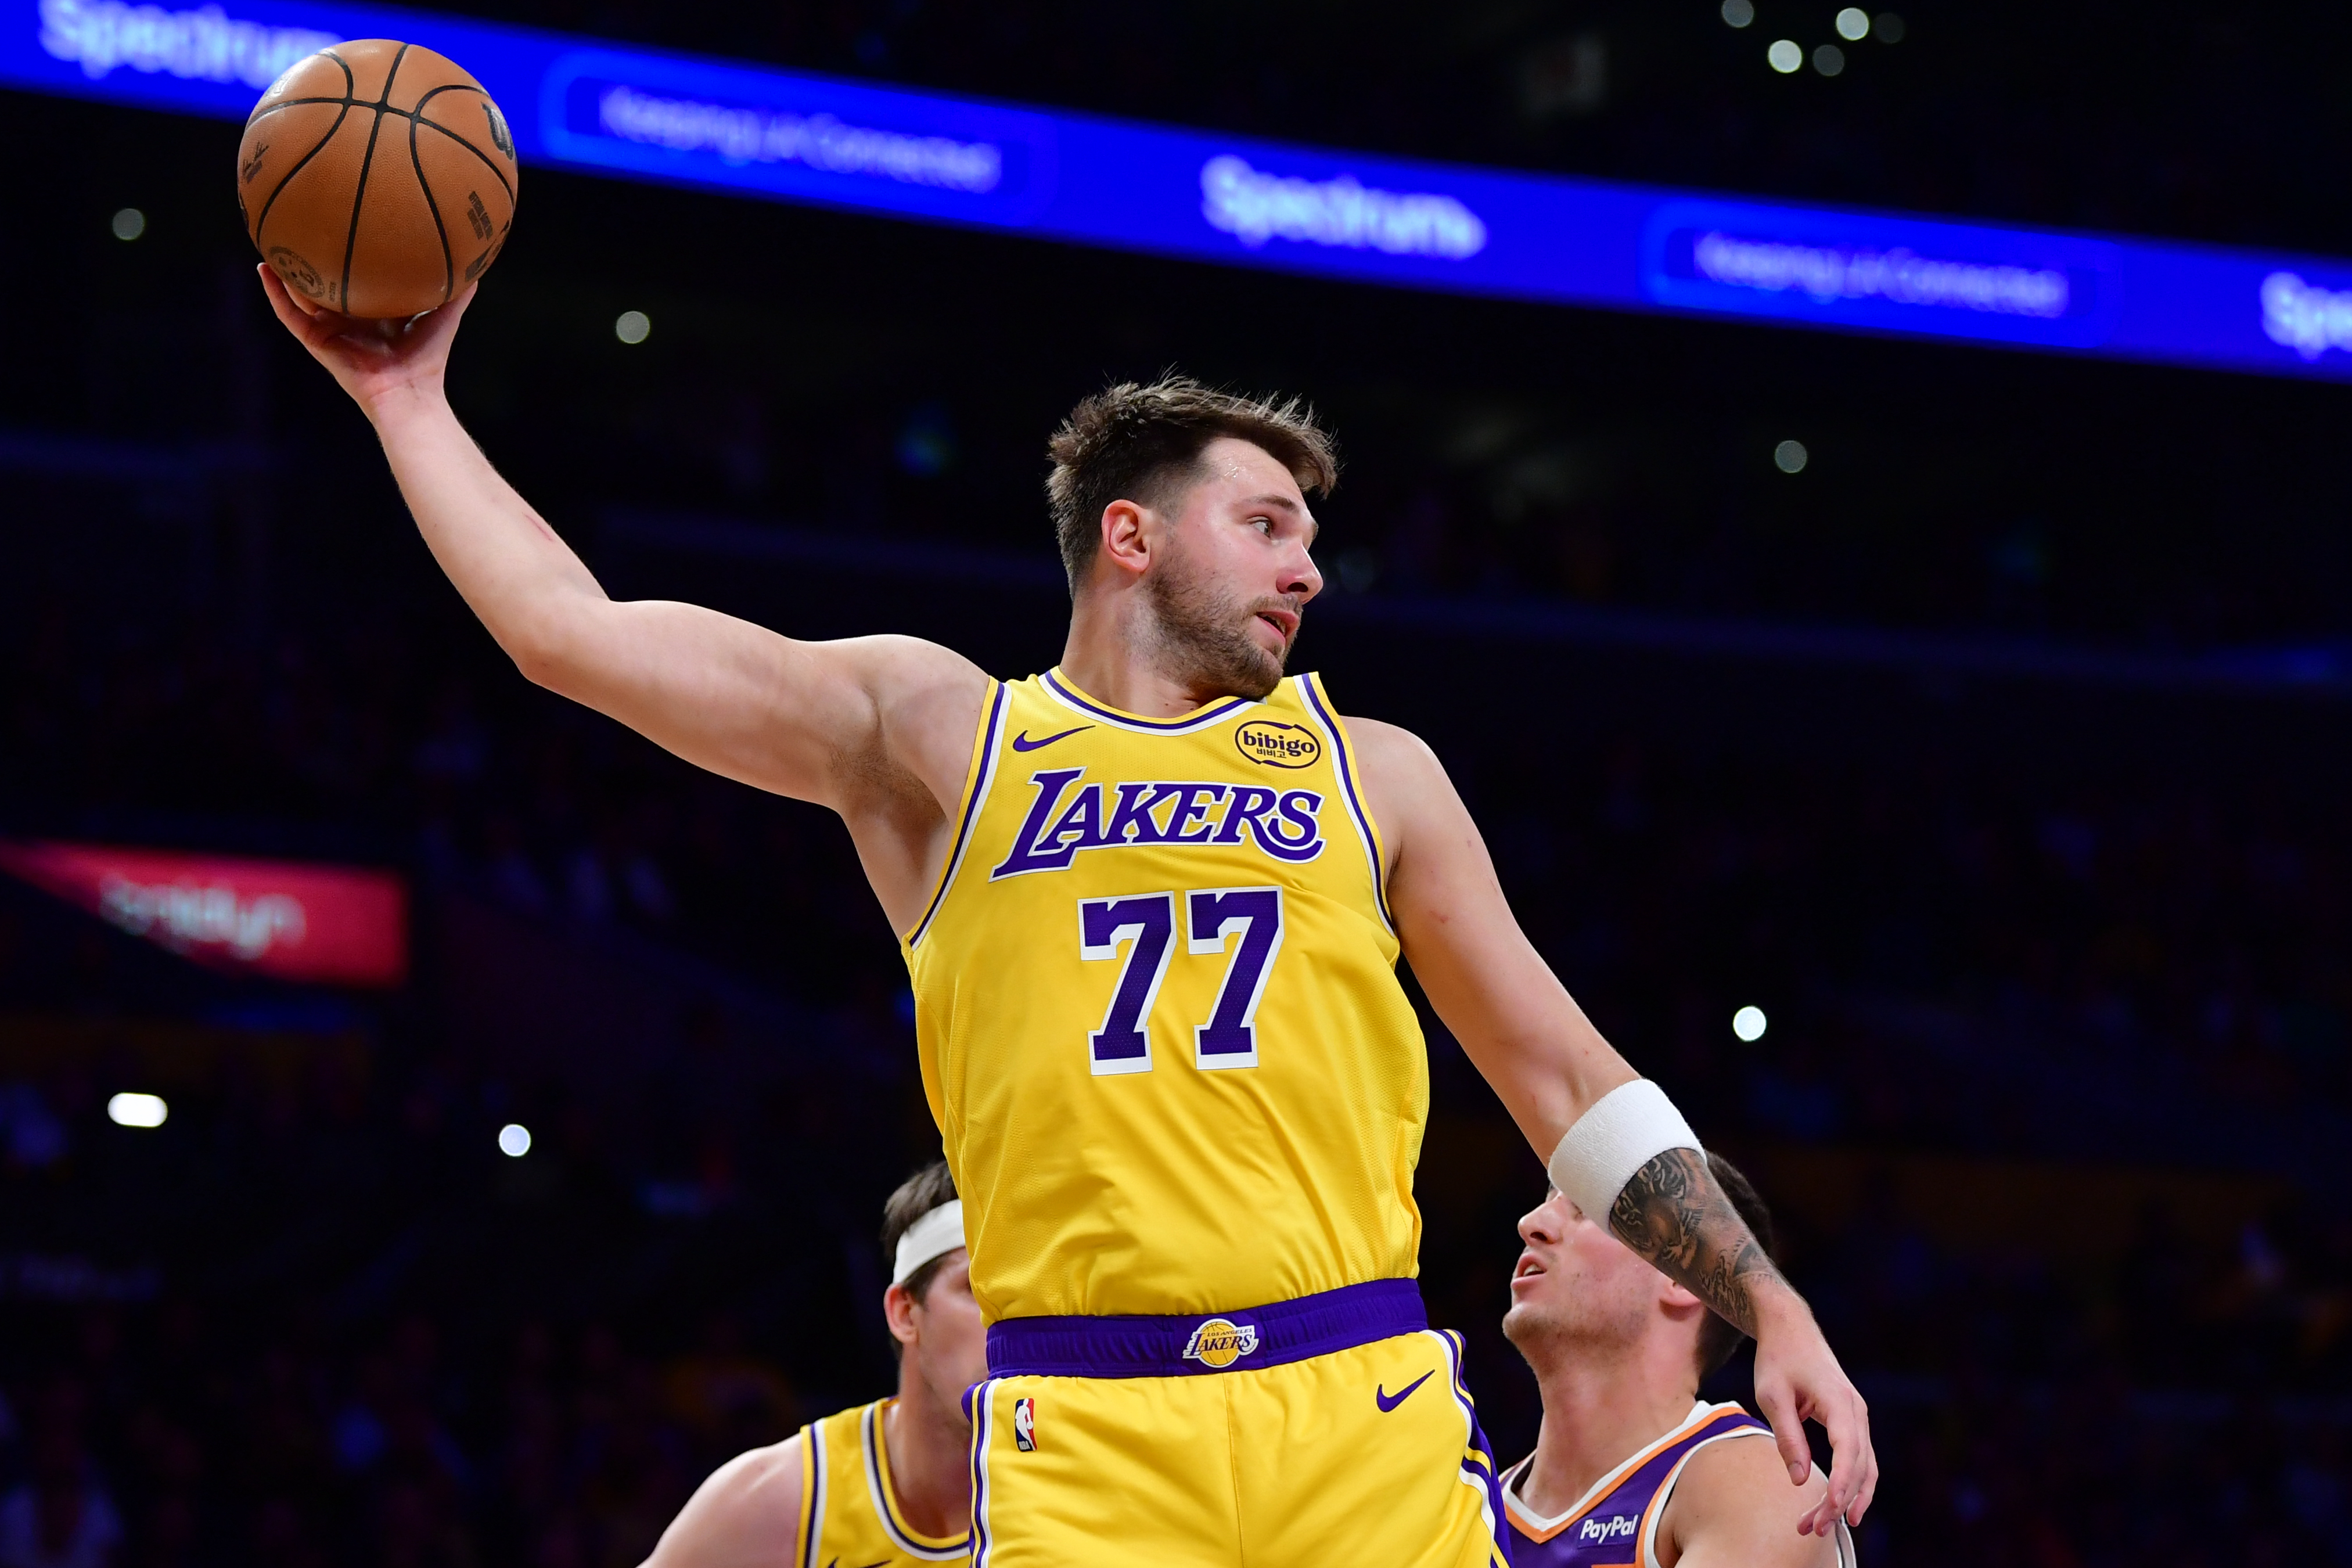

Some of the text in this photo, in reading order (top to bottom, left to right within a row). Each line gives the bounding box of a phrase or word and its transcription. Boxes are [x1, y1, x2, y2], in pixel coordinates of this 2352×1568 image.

[1201, 154, 1487, 260] Spectrum
[1243, 730, 1315, 757] bibigo
[1256, 747, 1287, 759] 비비고
[988, 766, 1327, 883] LAKERS
[1077, 886, 1284, 1076] 77
[1185, 1333, 1257, 1356] LAKERS
[1221, 1328, 1252, 1336] ANGELES
[1580, 1513, 1639, 1544] PayPal
